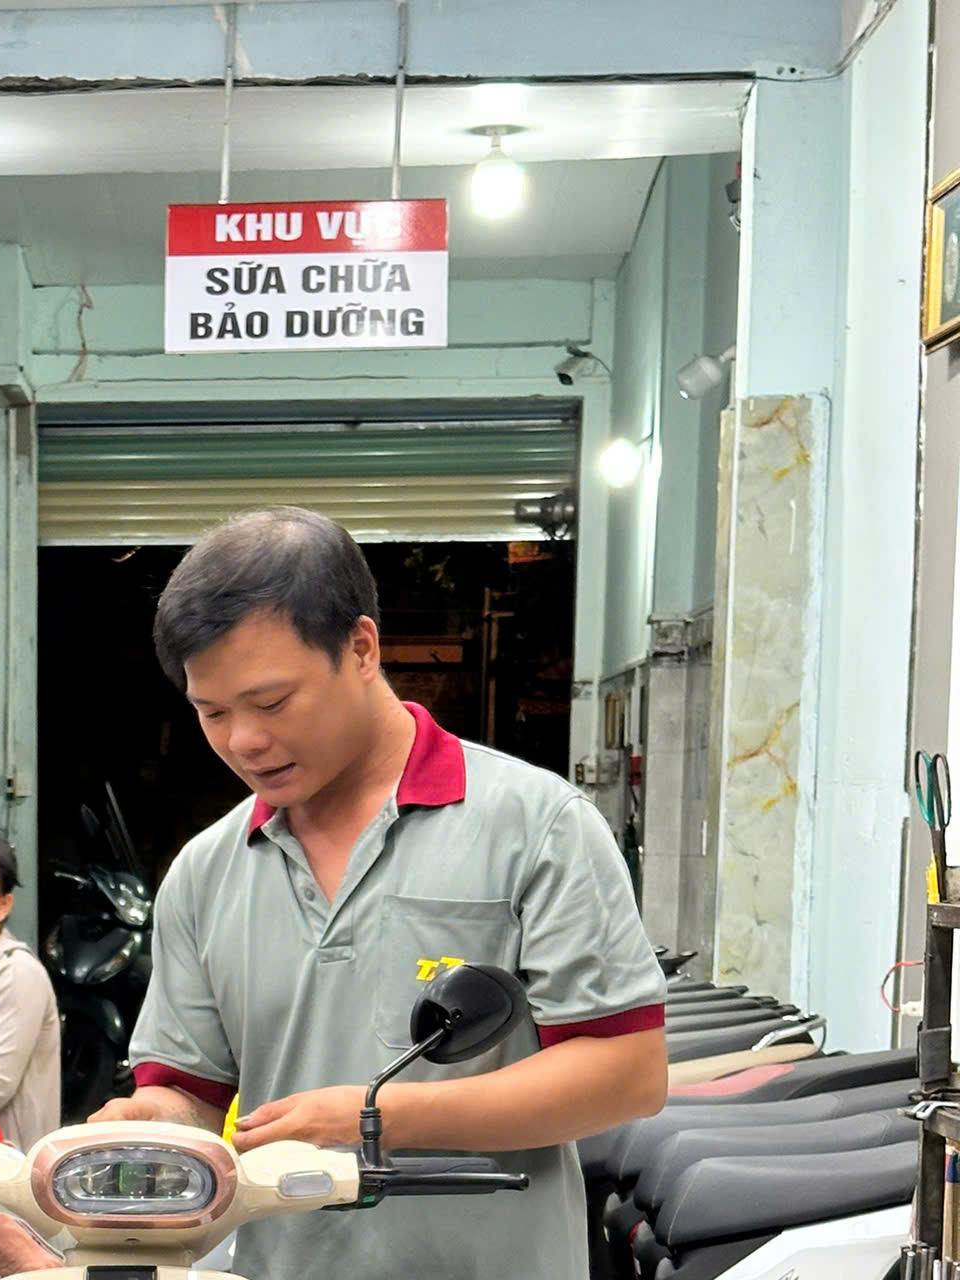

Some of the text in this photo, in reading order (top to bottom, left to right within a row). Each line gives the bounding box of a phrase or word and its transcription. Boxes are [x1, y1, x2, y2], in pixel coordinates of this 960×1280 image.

[215, 211, 303, 242] KHU
[190, 301, 425, 340] BẢO DƯỠNG
